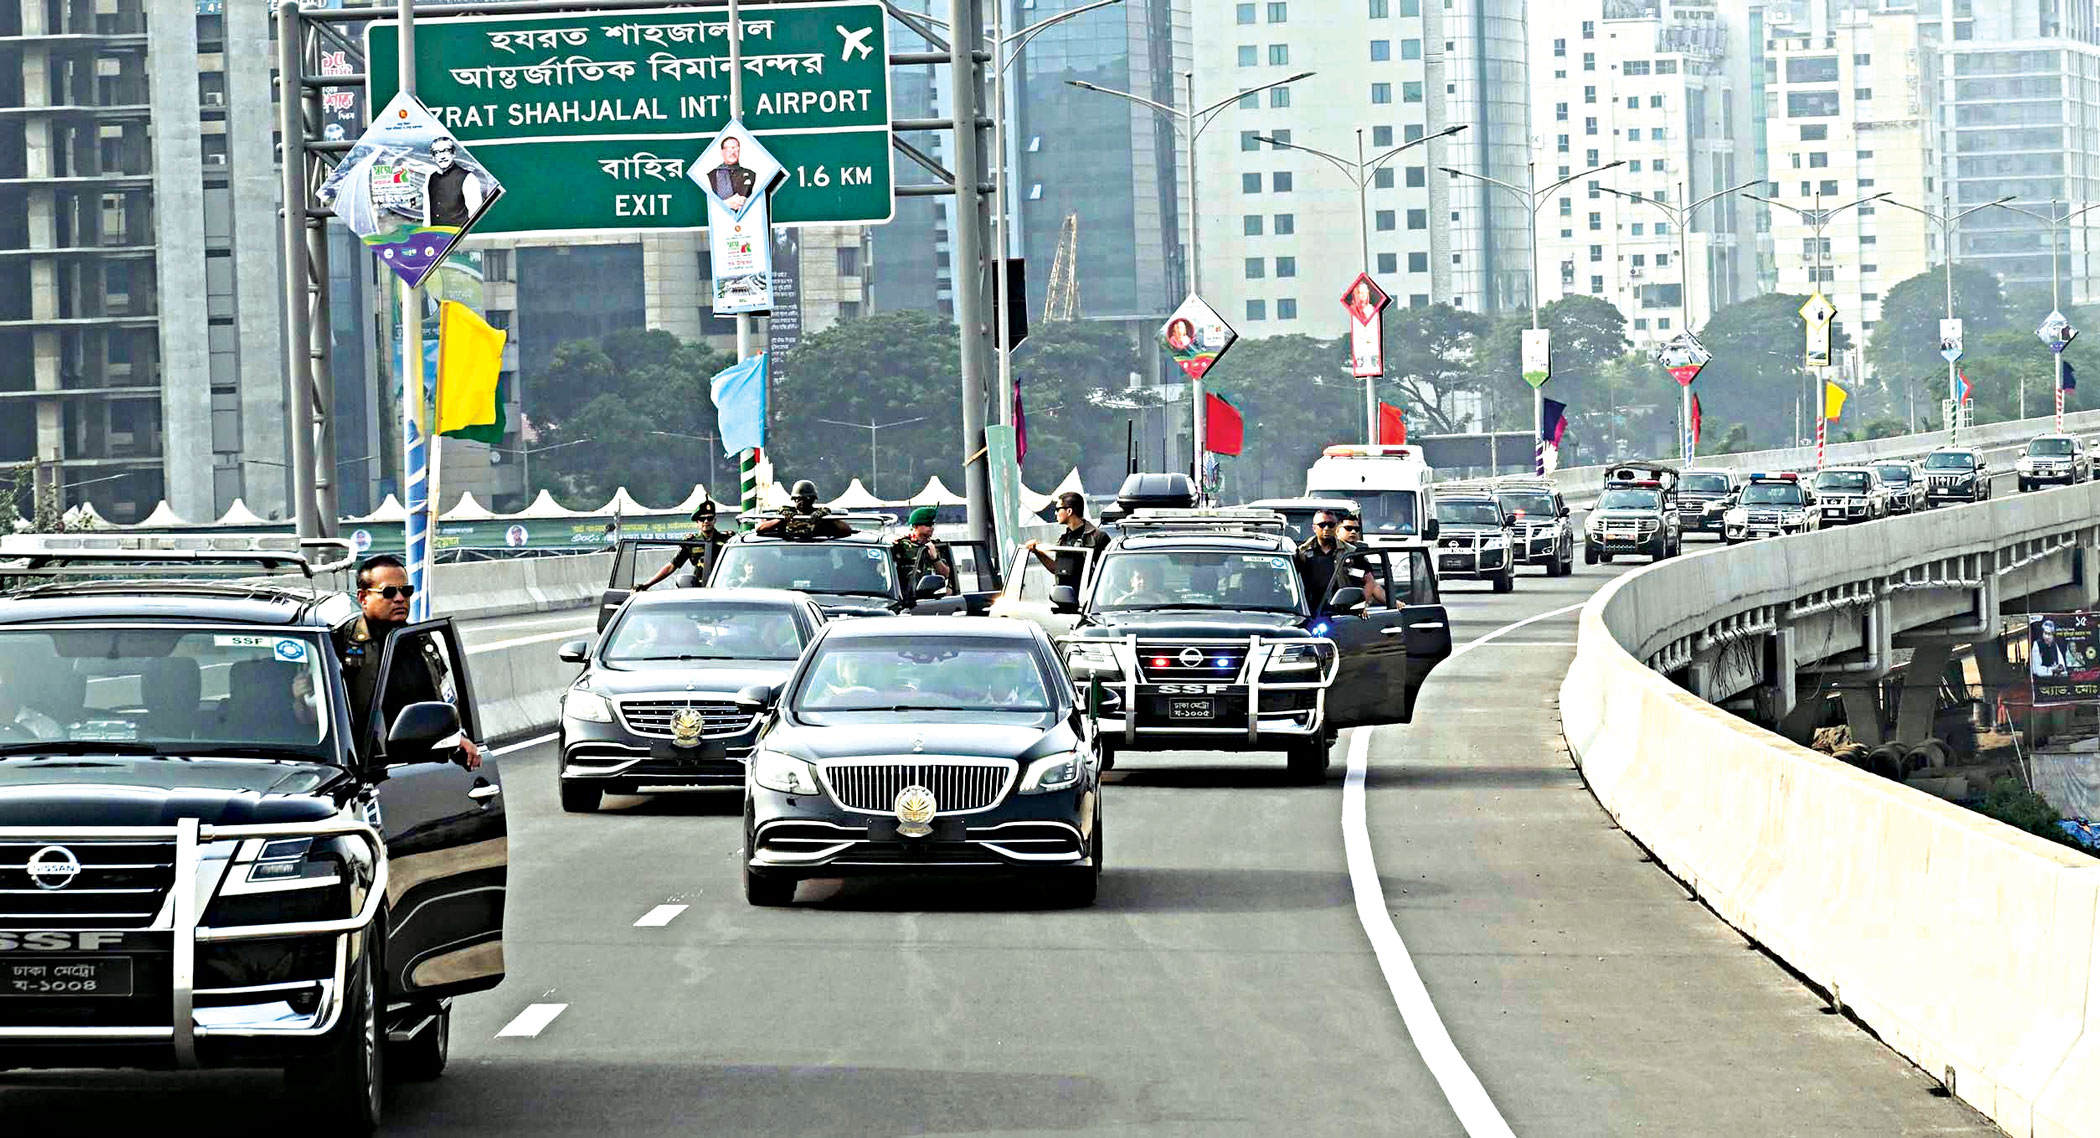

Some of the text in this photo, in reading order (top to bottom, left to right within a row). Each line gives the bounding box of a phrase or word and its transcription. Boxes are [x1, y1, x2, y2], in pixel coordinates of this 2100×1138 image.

[487, 19, 775, 54] হযরত শাহজালাল
[449, 52, 825, 89] আন্তর্জাতিক বিমানবন্দর
[508, 97, 668, 126] SHAHJALAL
[756, 89, 872, 116] AIRPORT
[598, 152, 685, 182] বাহির
[797, 165, 872, 188] 1.6 KM
[616, 194, 672, 216] EXIT
[232, 637, 263, 645] SSF
[1158, 684, 1228, 694] SSF
[12, 963, 96, 978] ঢাকা মেট্রো
